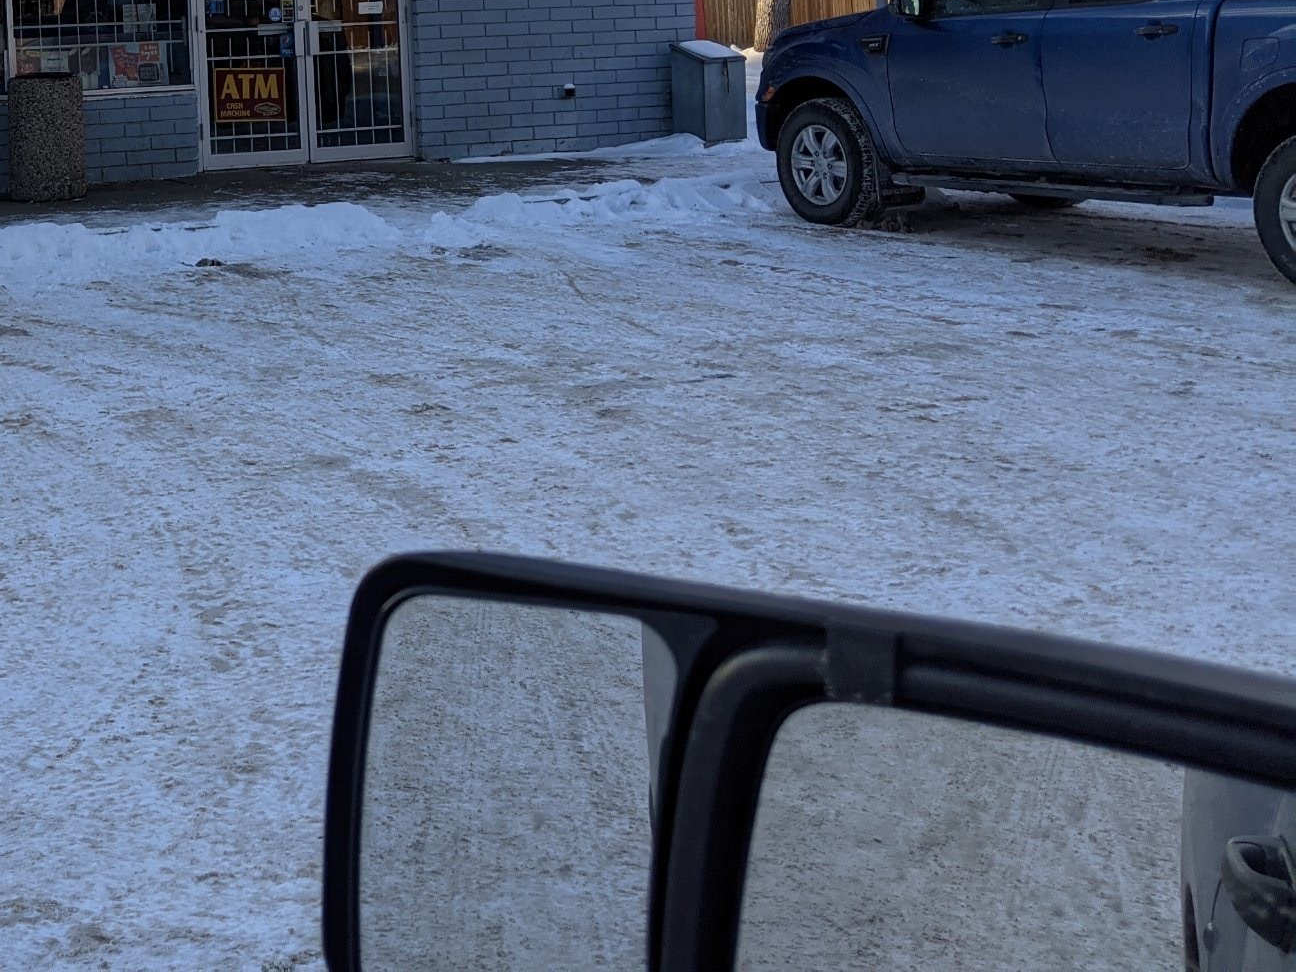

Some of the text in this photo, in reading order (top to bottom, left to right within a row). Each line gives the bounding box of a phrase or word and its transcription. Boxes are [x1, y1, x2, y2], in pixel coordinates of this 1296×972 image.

[220, 73, 279, 99] ATM
[226, 102, 244, 110] CASH
[220, 109, 251, 118] MACHINE
